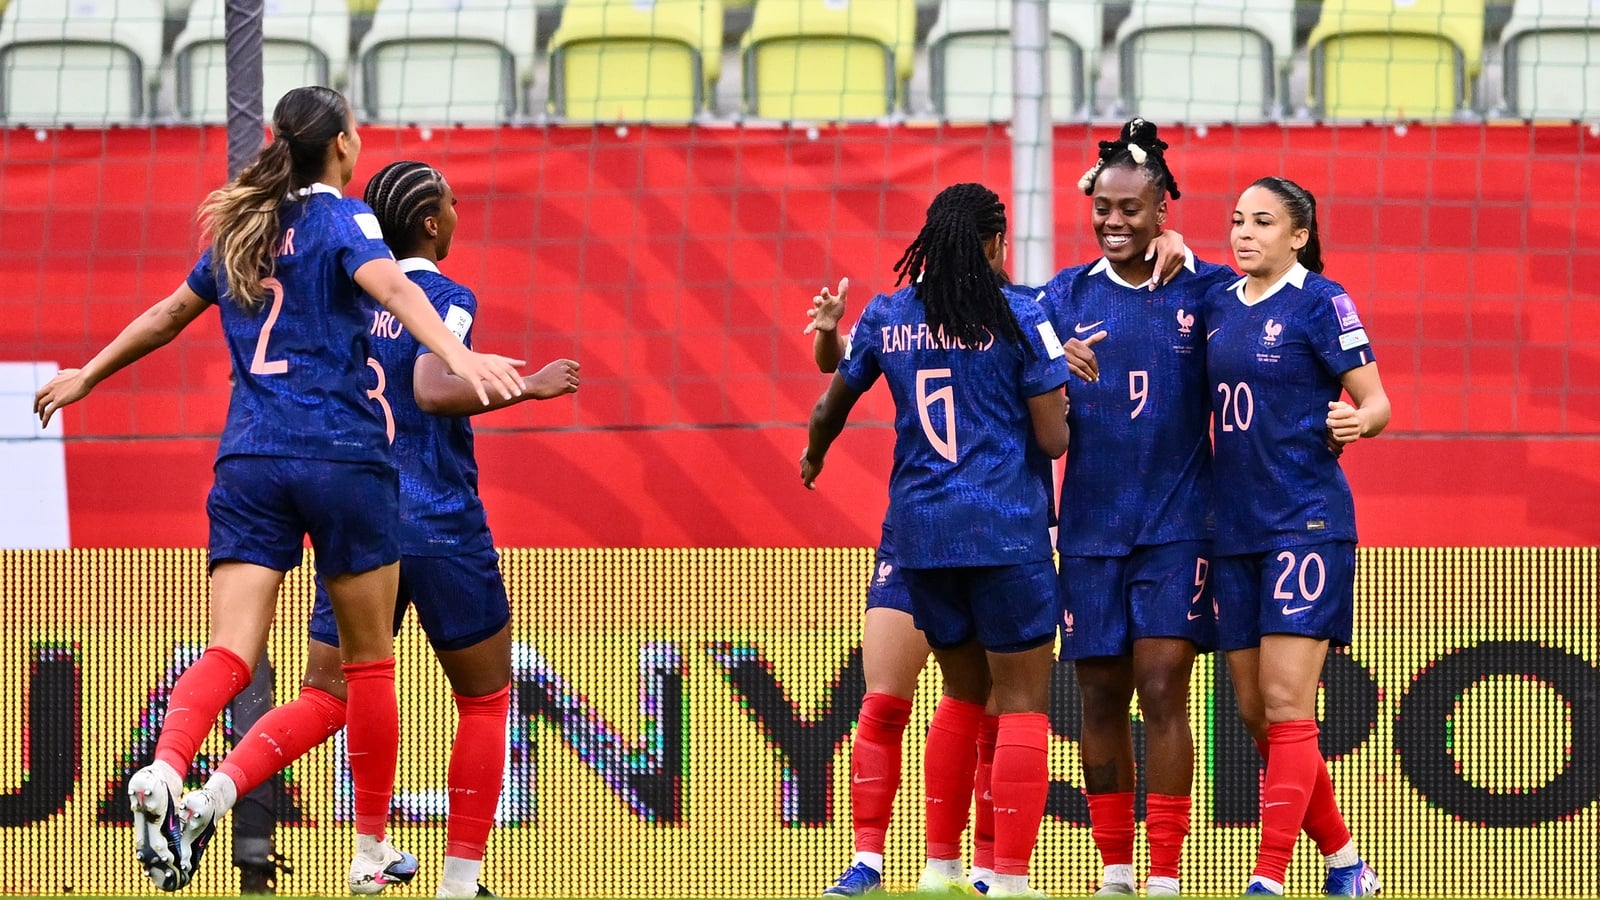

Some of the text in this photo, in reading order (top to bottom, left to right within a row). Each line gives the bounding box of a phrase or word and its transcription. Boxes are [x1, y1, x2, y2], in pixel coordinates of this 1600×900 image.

[250, 276, 289, 375] 2
[881, 322, 995, 354] JEAN-FRA
[916, 368, 958, 464] 6
[1128, 370, 1149, 420] 9
[1217, 381, 1254, 432] 20
[1191, 557, 1209, 604] 9
[1273, 551, 1326, 602] 20
